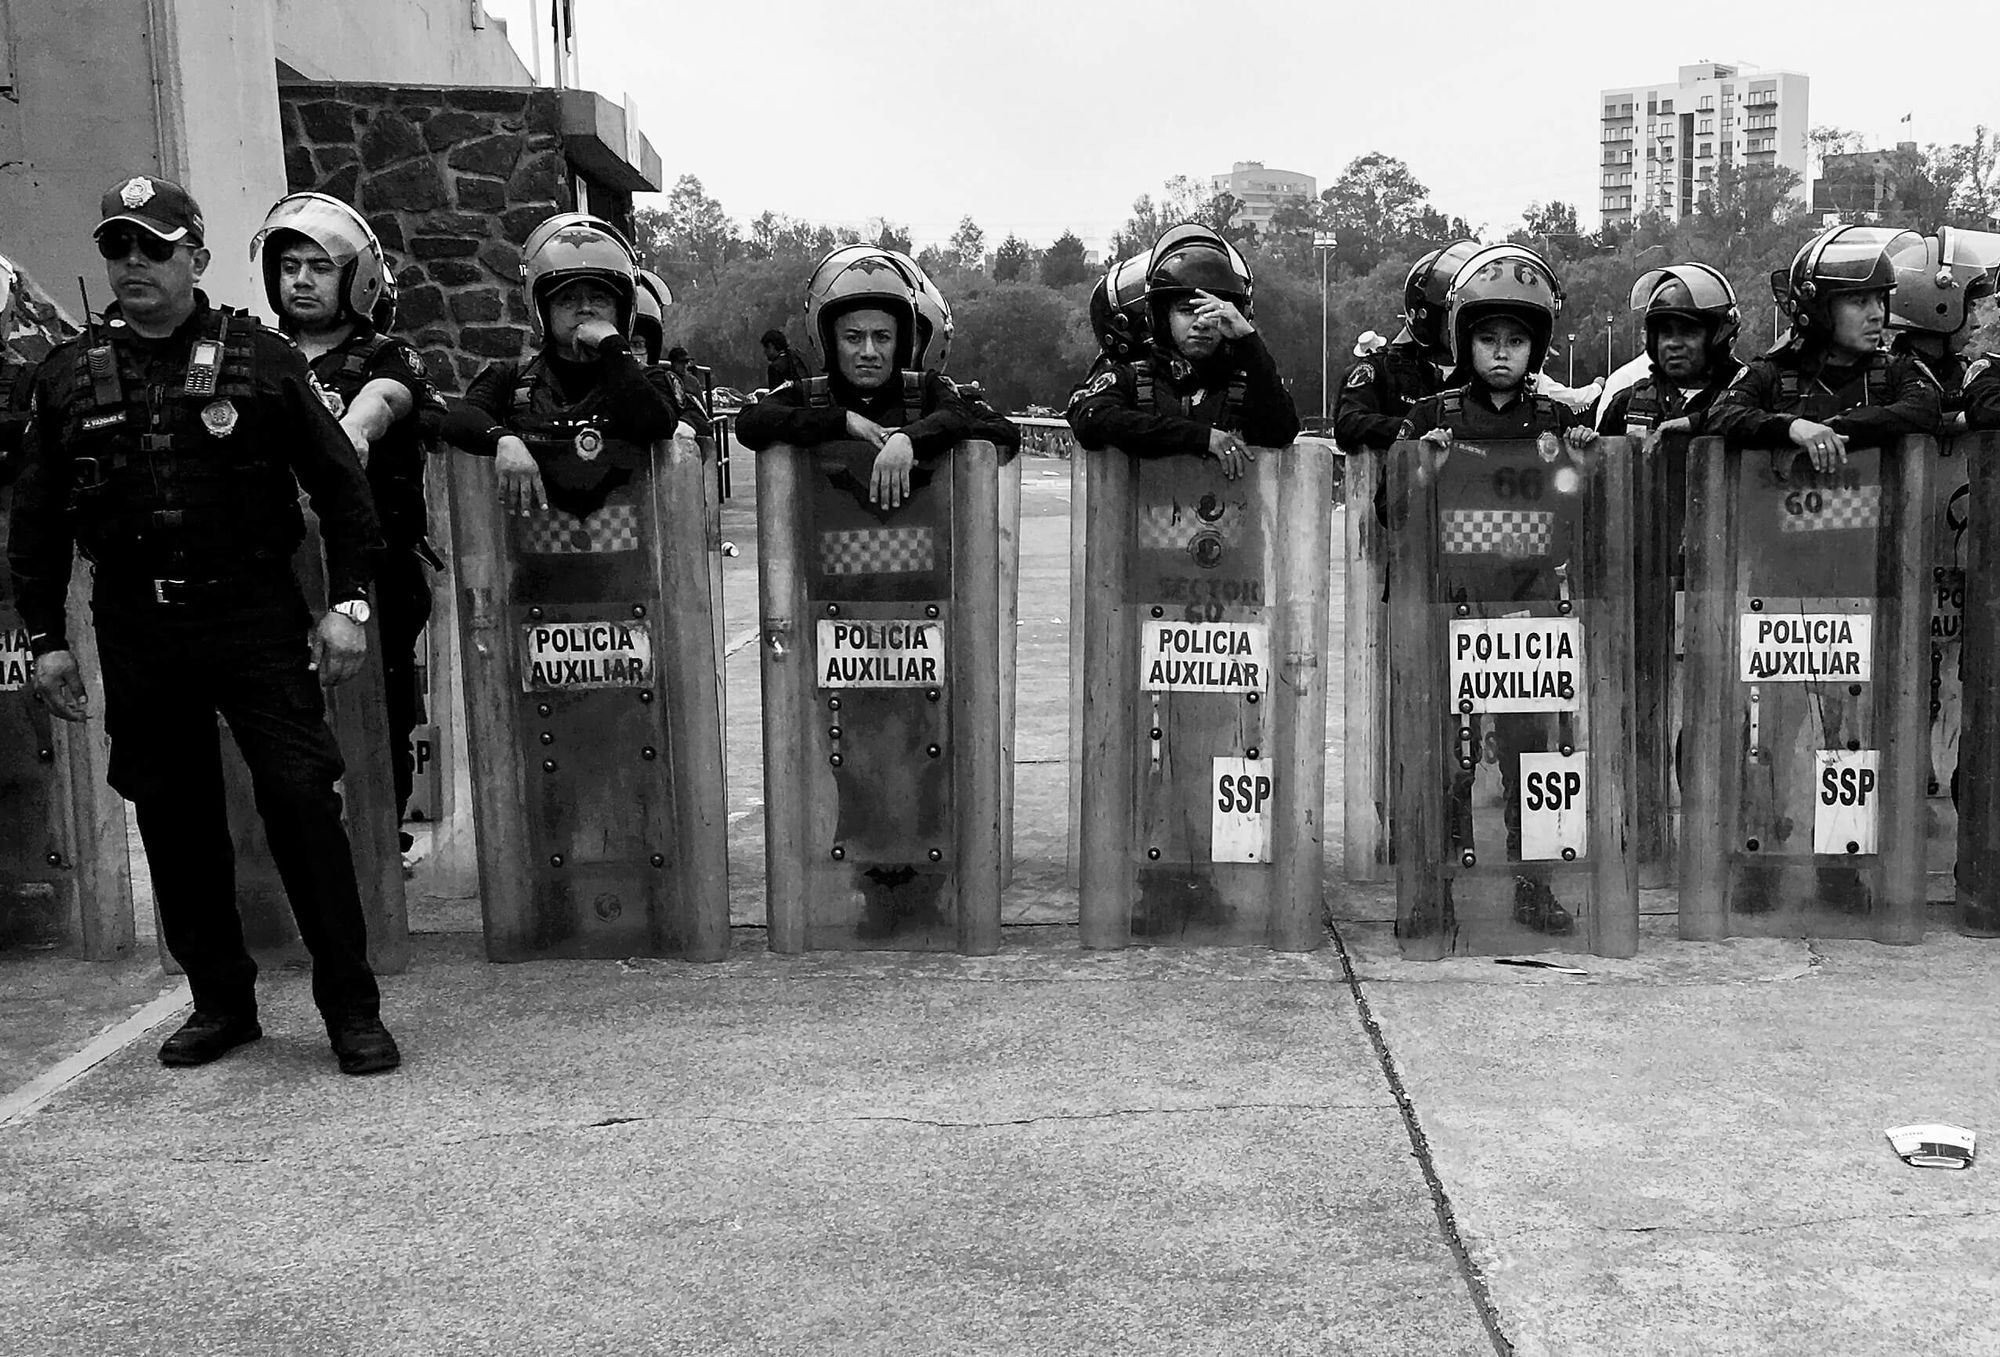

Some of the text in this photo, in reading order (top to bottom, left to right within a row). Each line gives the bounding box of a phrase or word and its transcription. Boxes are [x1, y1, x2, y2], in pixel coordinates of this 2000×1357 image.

[536, 626, 635, 653] POLICIA
[834, 625, 929, 650] POLICIA
[1159, 628, 1252, 655] POLICIA
[1758, 620, 1853, 644] POLICIA
[1457, 632, 1573, 661] POLICIA
[531, 657, 644, 685] AUXILIAR
[826, 656, 937, 682] AUXILIAR
[1148, 660, 1259, 686] AUXILIAR
[1748, 651, 1860, 678] AUXILIAR
[1218, 774, 1271, 814] SSP
[1526, 771, 1581, 812] SSP
[1821, 767, 1875, 806] SSP
